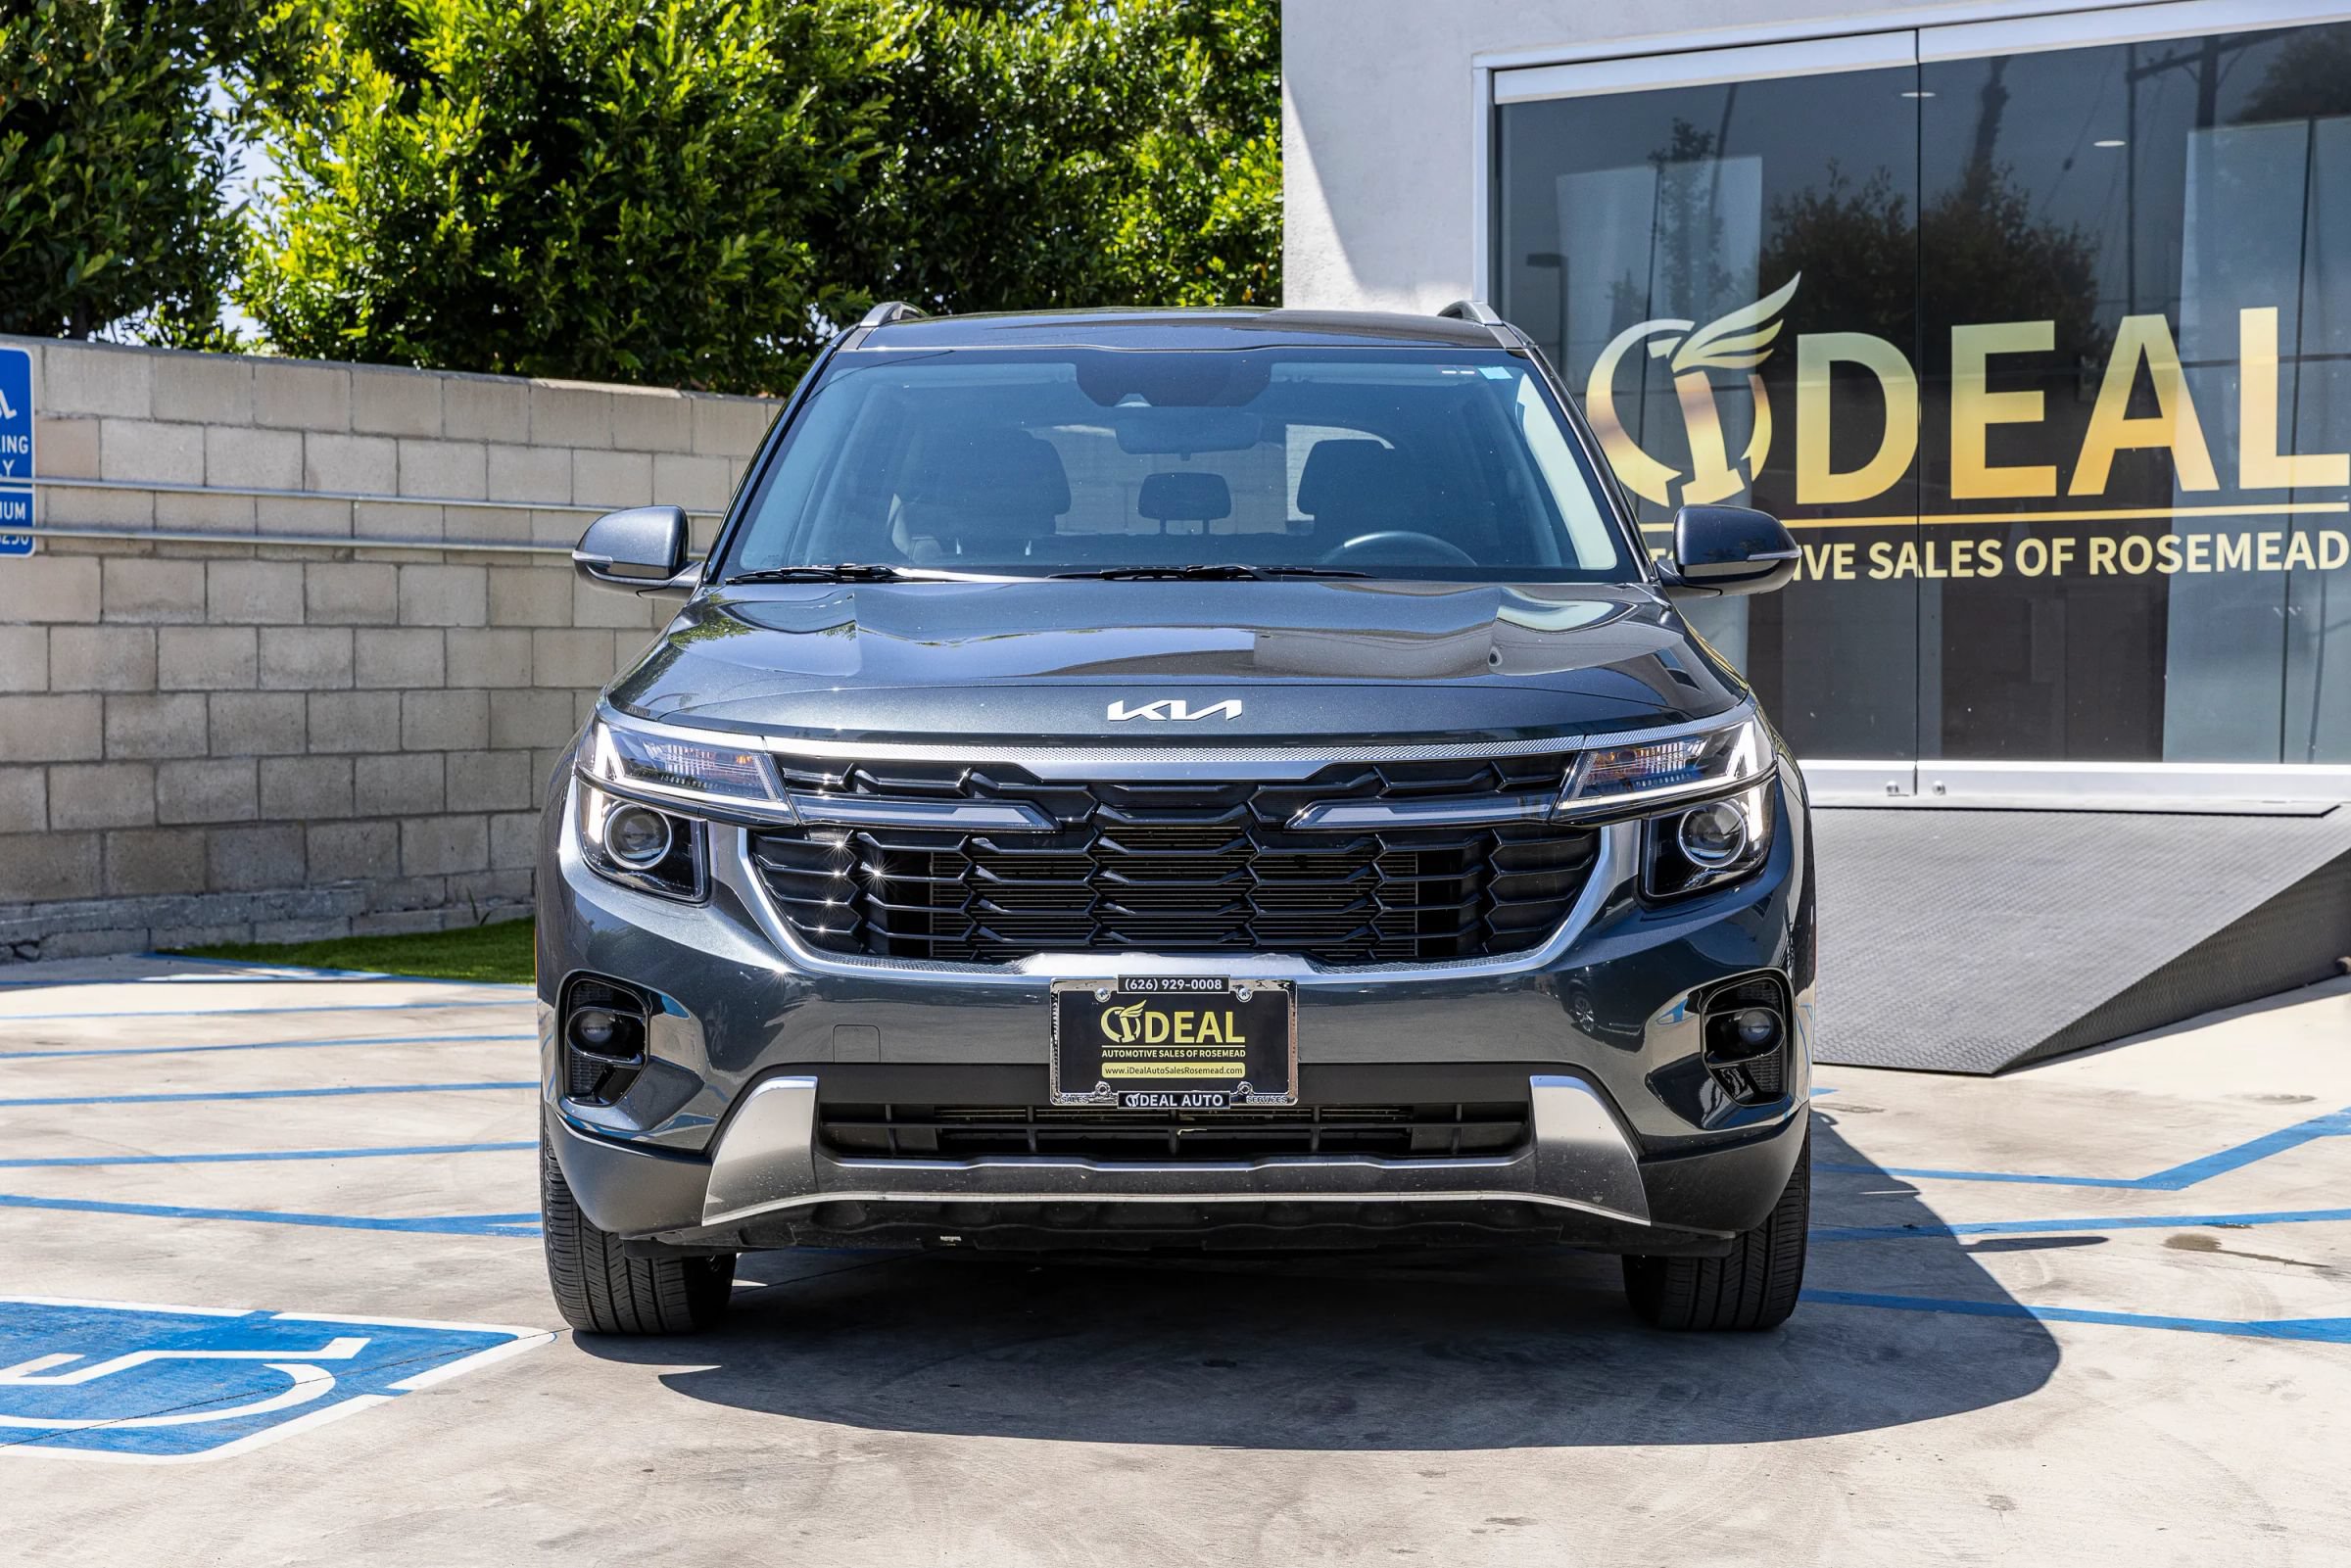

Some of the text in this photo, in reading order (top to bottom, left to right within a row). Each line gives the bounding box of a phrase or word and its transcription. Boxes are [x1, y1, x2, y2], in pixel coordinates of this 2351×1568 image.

[0, 435, 29, 454] ING
[1867, 539, 2004, 581] SALES
[2014, 537, 2076, 578] OF
[2088, 530, 2350, 576] ROSEMEAD
[1107, 699, 1243, 722] KIA
[1125, 977, 1223, 992] (626) 929-0008
[1101, 1049, 1246, 1059] AUTOMOTIVE SALES OF ROSEMEAD
[1104, 1066, 1243, 1075] www.iDealAutoSalesRosemead.com
[1180, 1094, 1223, 1107] AUTO
